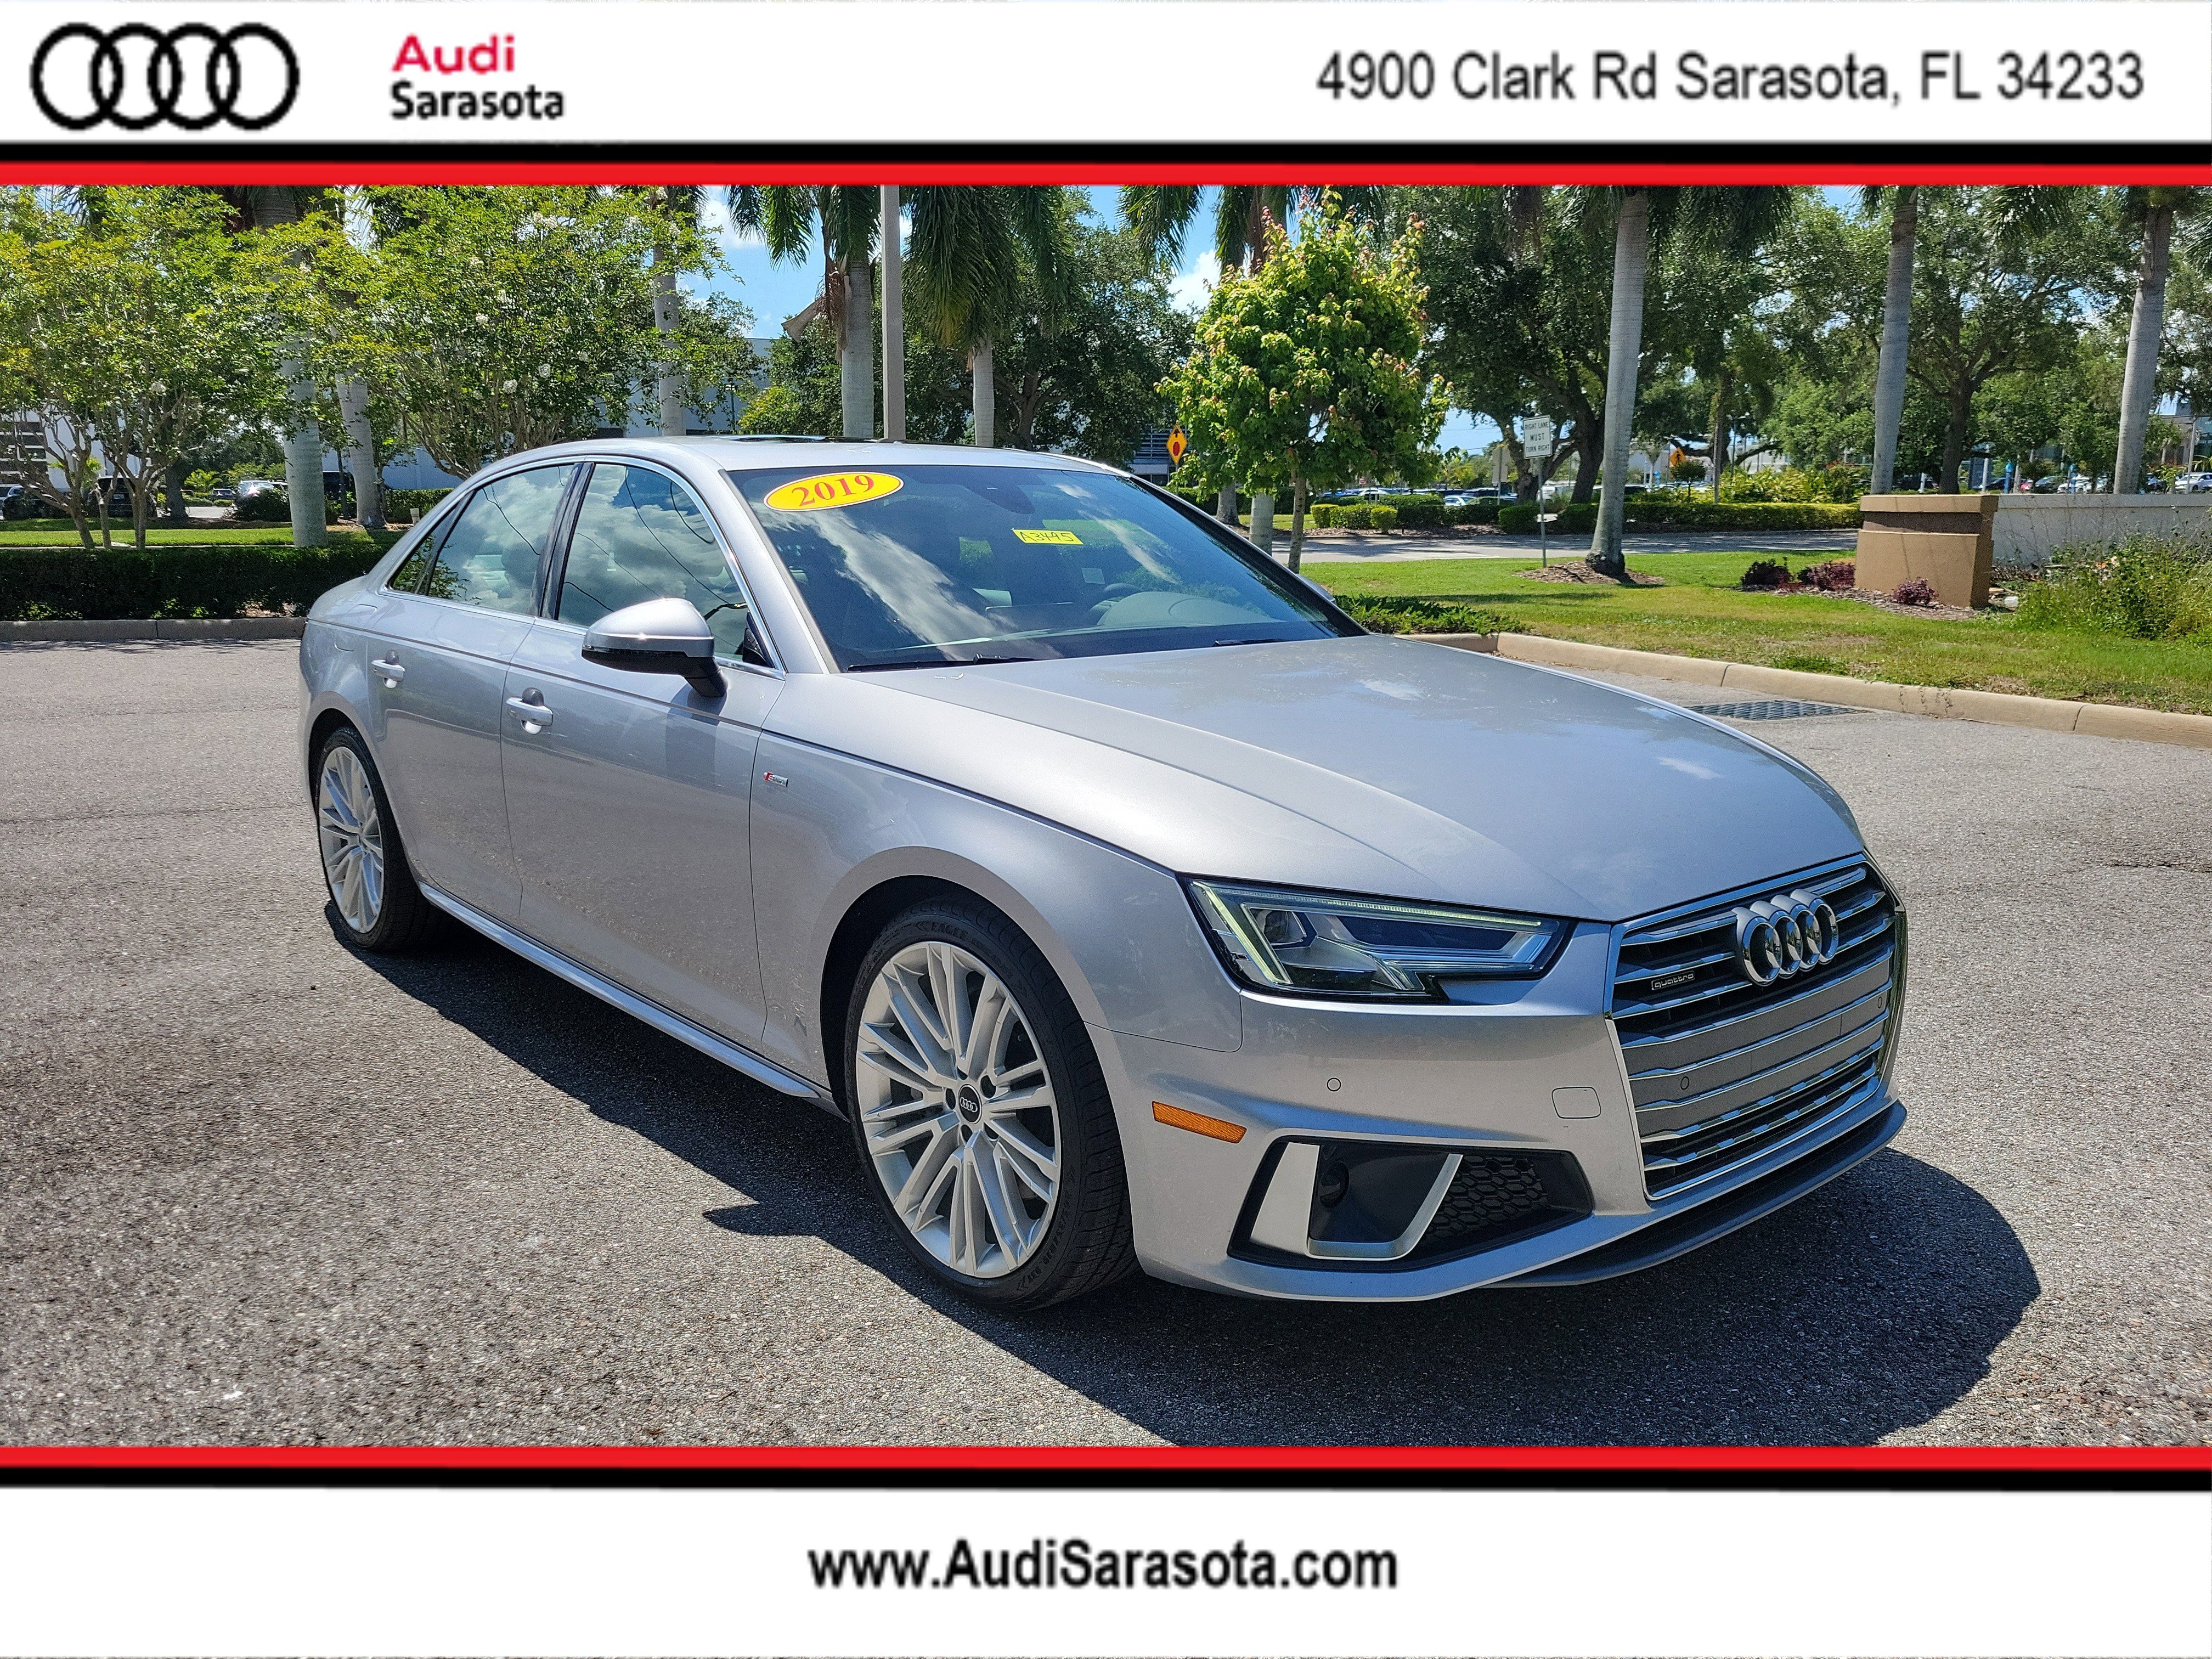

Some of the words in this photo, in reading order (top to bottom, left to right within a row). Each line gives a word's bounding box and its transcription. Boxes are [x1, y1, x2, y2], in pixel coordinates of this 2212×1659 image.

[1530, 433, 1544, 441] MUST
[792, 475, 874, 507] 2019
[1019, 532, 1074, 542] A3495
[931, 921, 968, 941] EAGLE
[1654, 973, 1694, 989] quattro
